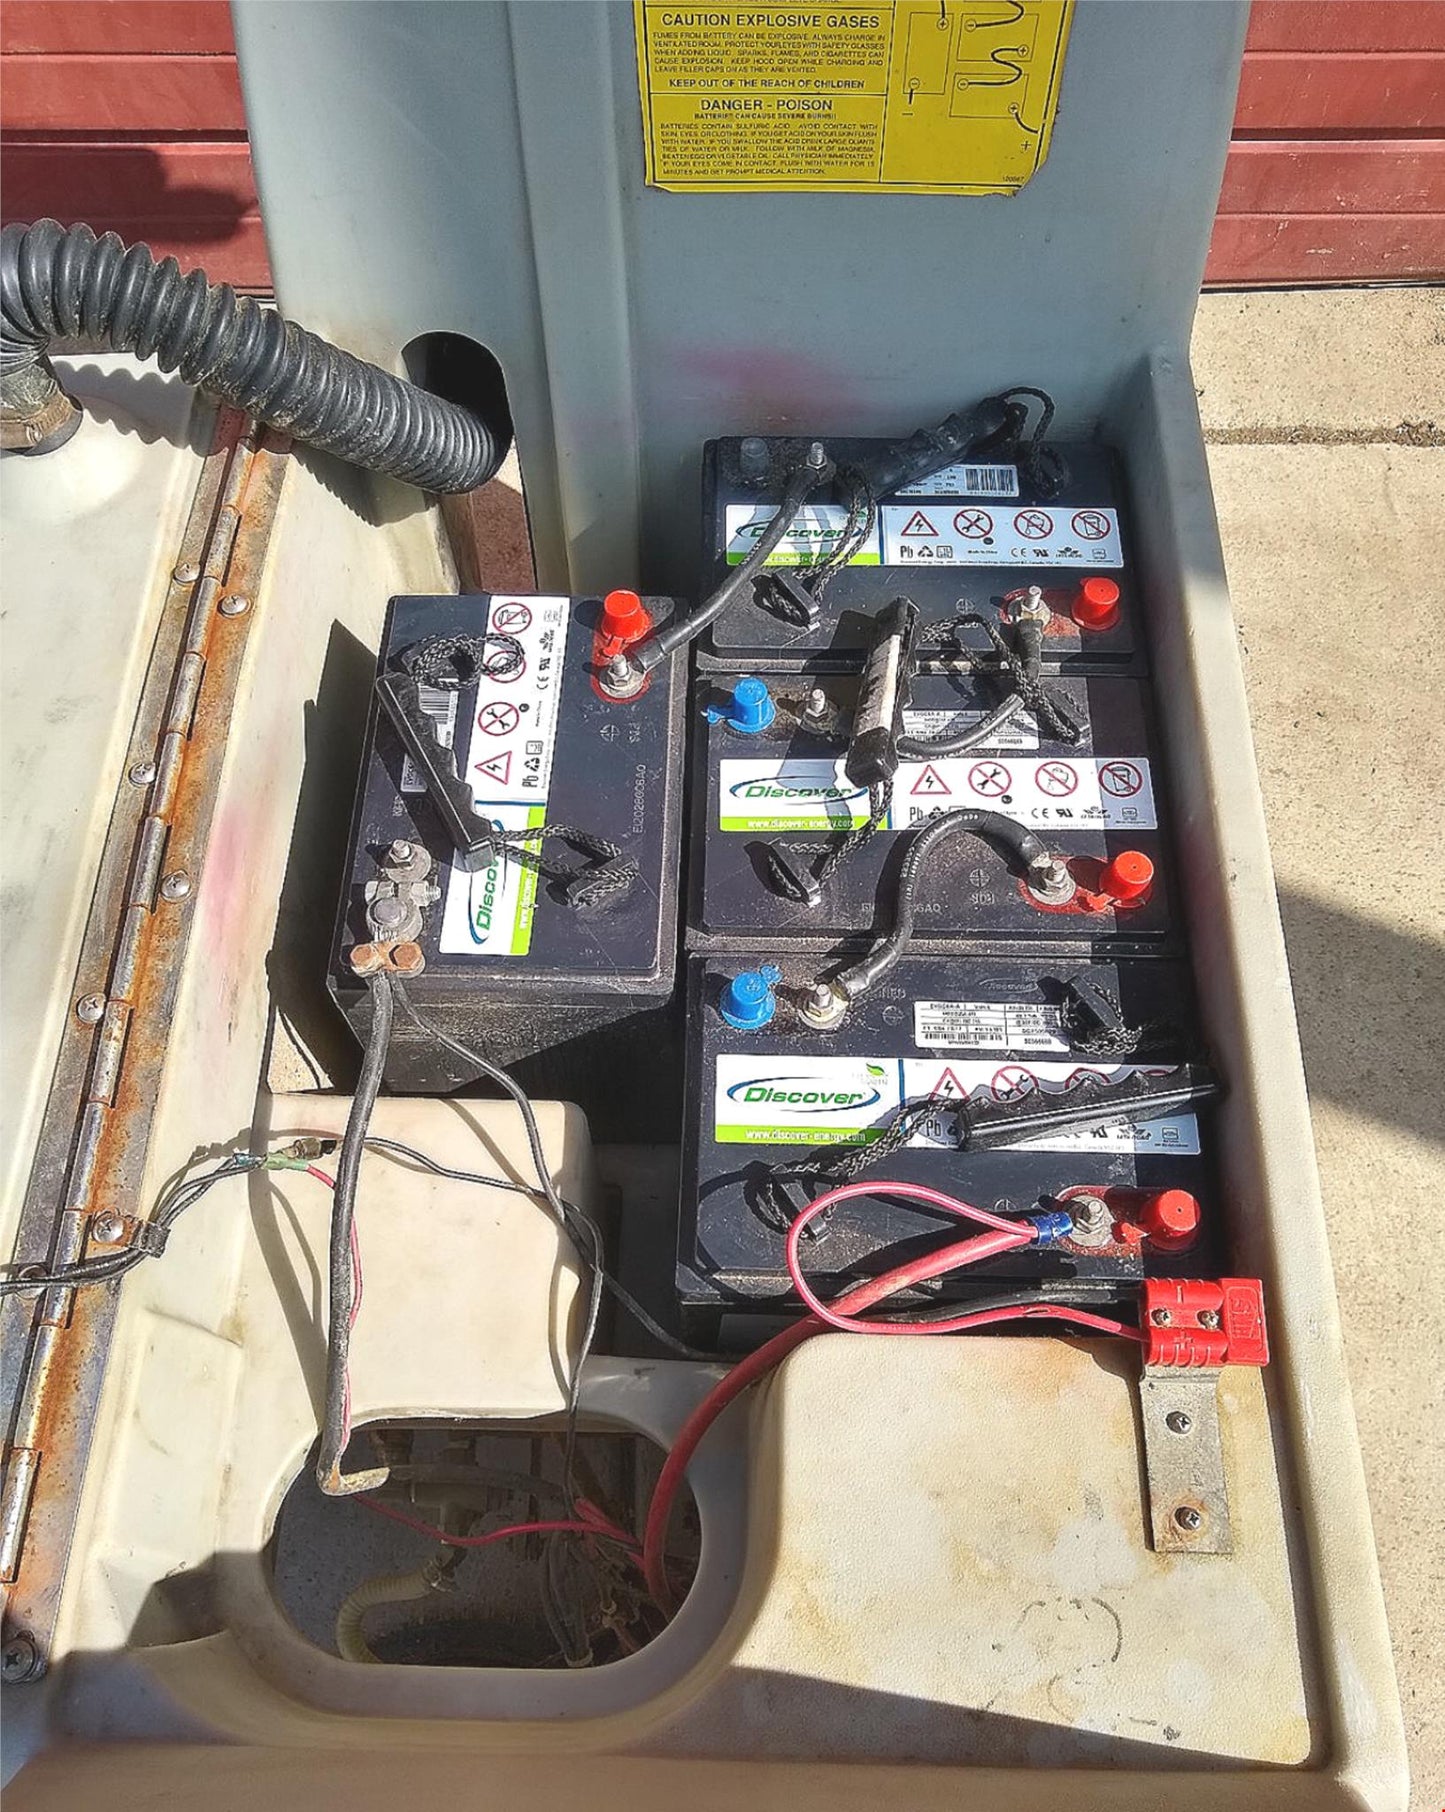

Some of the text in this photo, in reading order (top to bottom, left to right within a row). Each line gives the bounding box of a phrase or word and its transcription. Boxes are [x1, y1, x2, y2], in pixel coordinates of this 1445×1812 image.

[662, 14, 880, 28] CAUTION EXPLOSIVE GASES
[704, 32, 736, 40] BATTERY
[669, 79, 696, 87] KEEP
[698, 79, 720, 87] OUT
[738, 80, 758, 88] THE
[760, 80, 796, 88] REACH
[798, 80, 812, 88] OF
[814, 80, 865, 88] CHILDREN
[701, 100, 763, 110] DANGER
[776, 100, 833, 110] POISON
[745, 785, 852, 798] Discover
[909, 806, 924, 821] Pb
[744, 1087, 863, 1105] Discover
